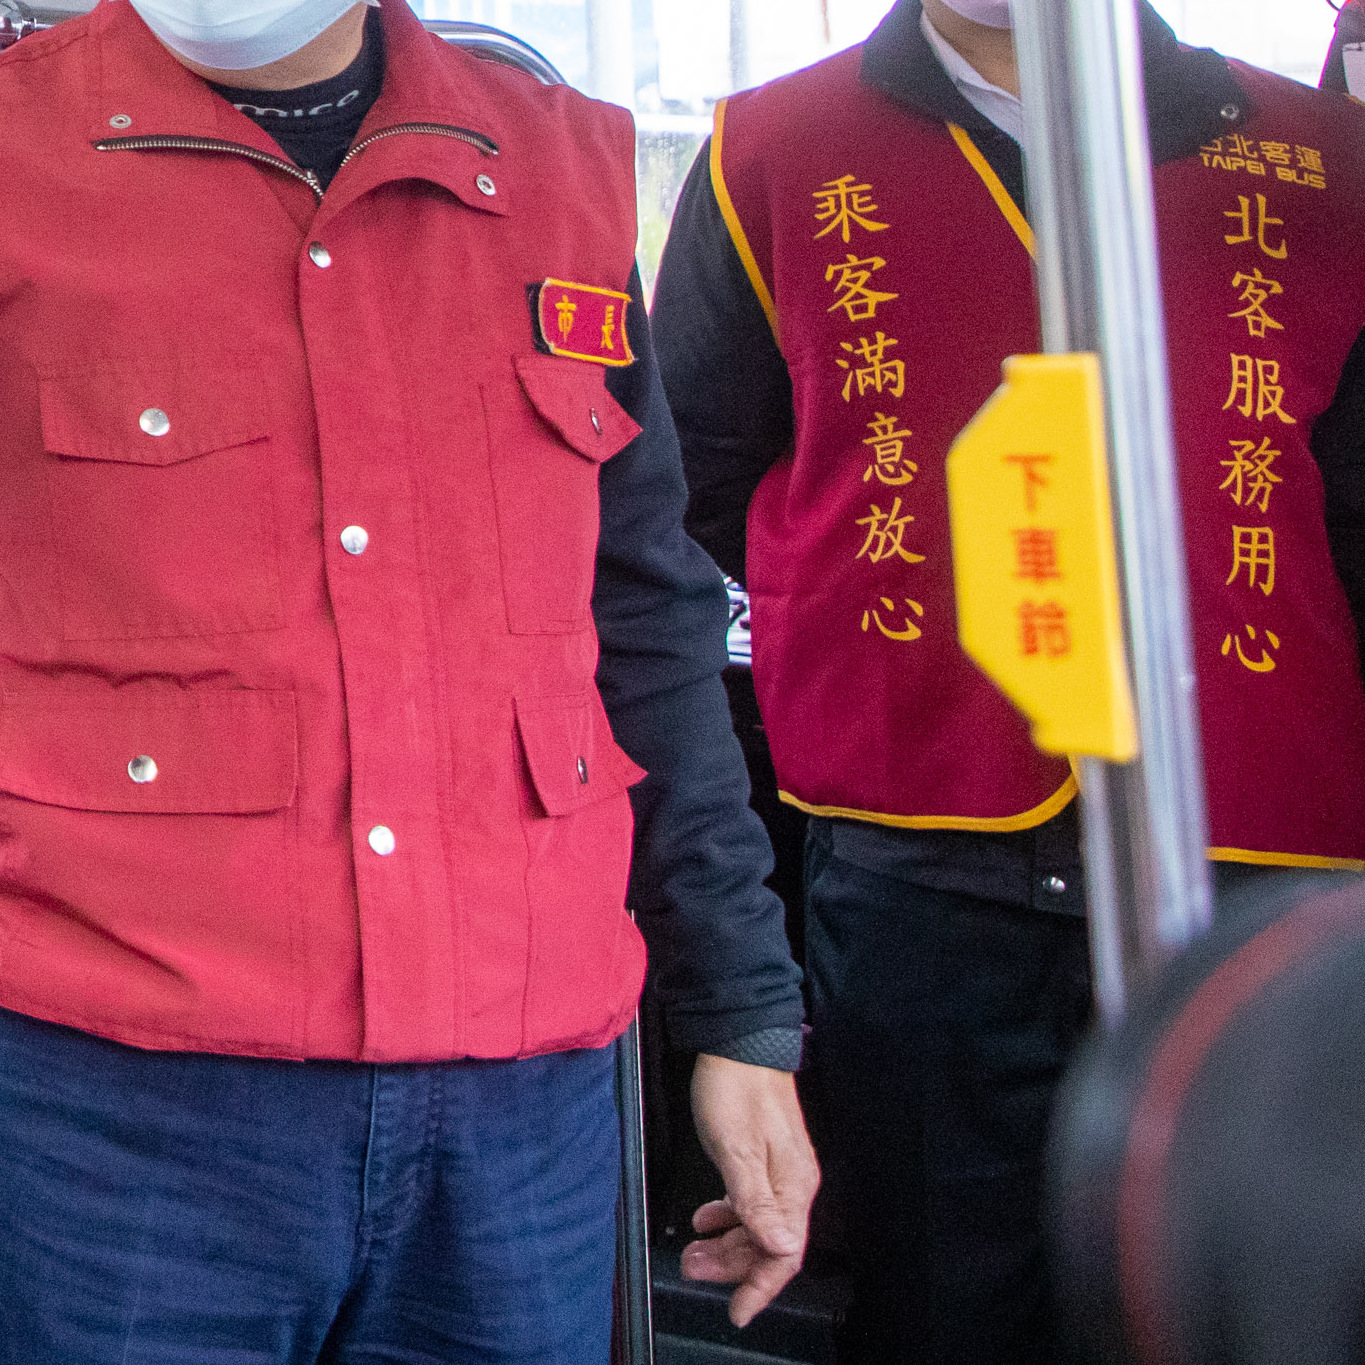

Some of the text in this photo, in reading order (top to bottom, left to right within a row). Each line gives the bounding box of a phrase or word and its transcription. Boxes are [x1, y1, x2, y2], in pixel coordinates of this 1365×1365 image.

[1199, 152, 1327, 190] TAIPEI BUS
[810, 174, 926, 642] 乘客滿意放心
[1001, 453, 1071, 659] 下車鈴
[1219, 192, 1296, 673] 北客服務用心
